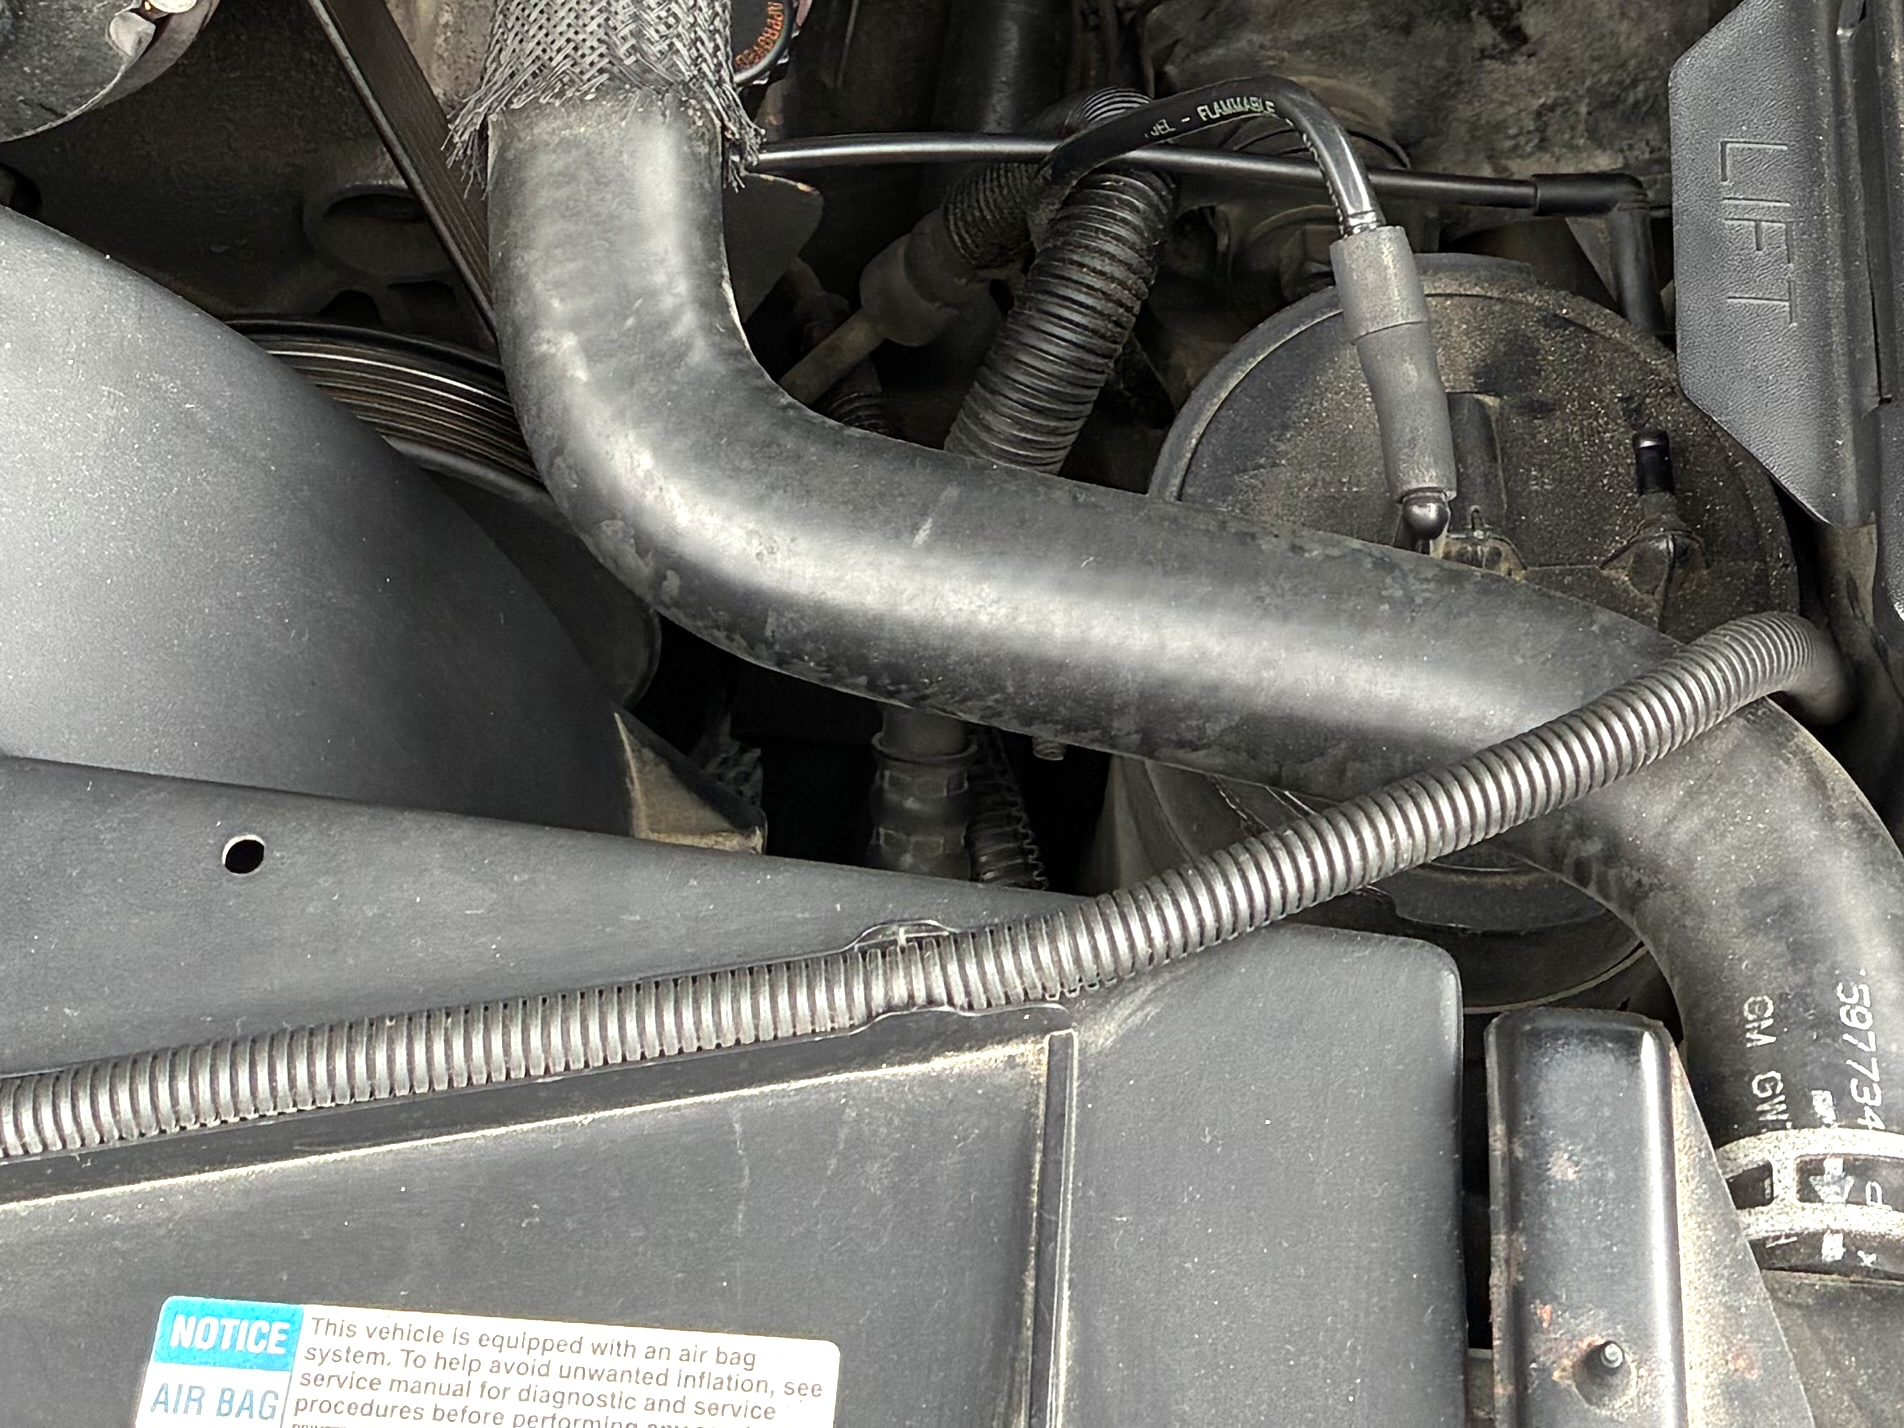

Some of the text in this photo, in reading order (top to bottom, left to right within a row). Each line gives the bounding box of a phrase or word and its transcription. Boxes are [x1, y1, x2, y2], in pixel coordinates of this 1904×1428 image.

[1196, 96, 1277, 122] FLAMMABLE
[1719, 139, 1800, 329] LIFT
[168, 1313, 291, 1356] NOTICE
[311, 1317, 757, 1372] This vehicle is equipped with an air bag
[303, 1345, 824, 1398] system. To help avoid unwanted inflation, see
[150, 1382, 280, 1421] AIR BAG
[293, 1396, 424, 1421] procedures
[431, 1402, 505, 1427] before
[299, 1371, 777, 1420] service manual for diagnostic and service
